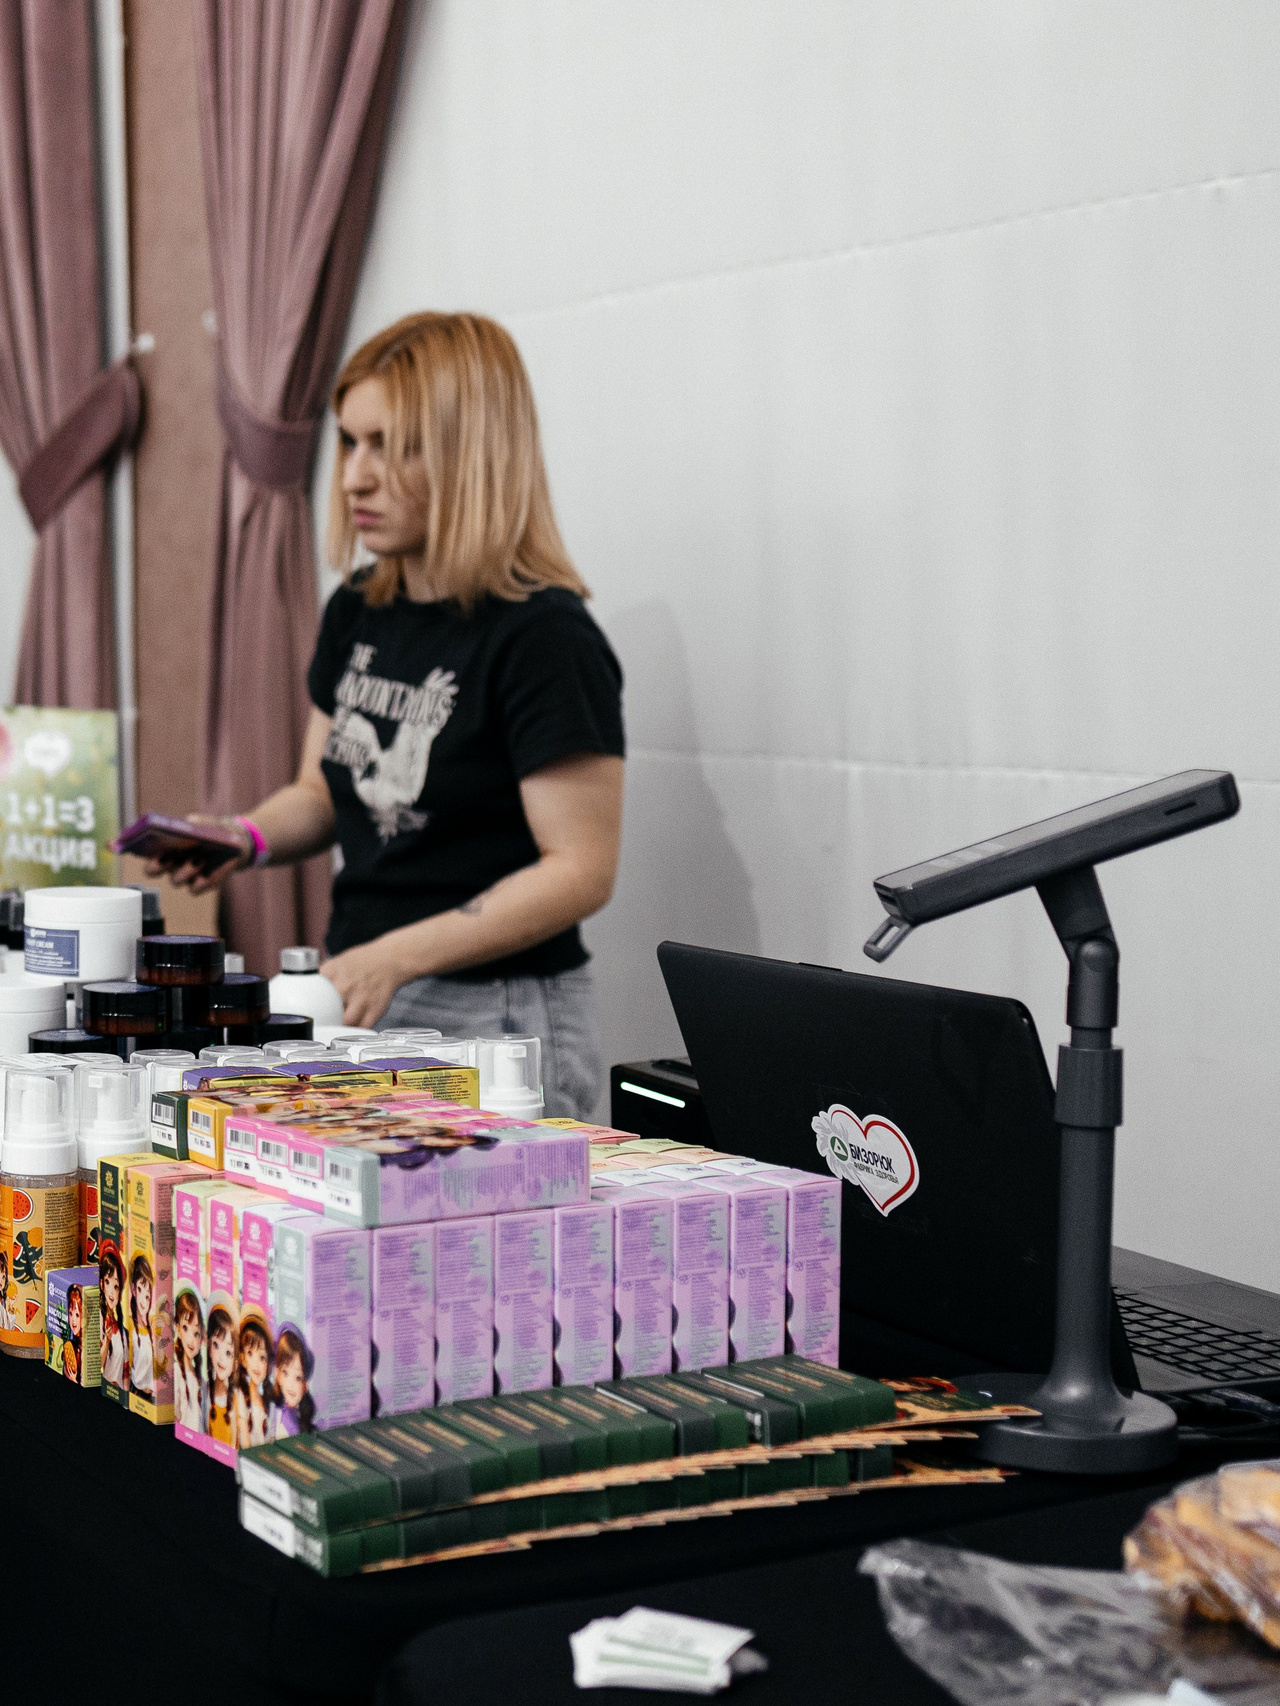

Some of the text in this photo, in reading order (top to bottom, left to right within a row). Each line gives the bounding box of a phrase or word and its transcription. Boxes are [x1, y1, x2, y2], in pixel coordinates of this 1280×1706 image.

[6, 793, 96, 833] 1+1=3
[4, 834, 97, 872] АКЦИЯ
[848, 1142, 896, 1174] БИЗОРЮК
